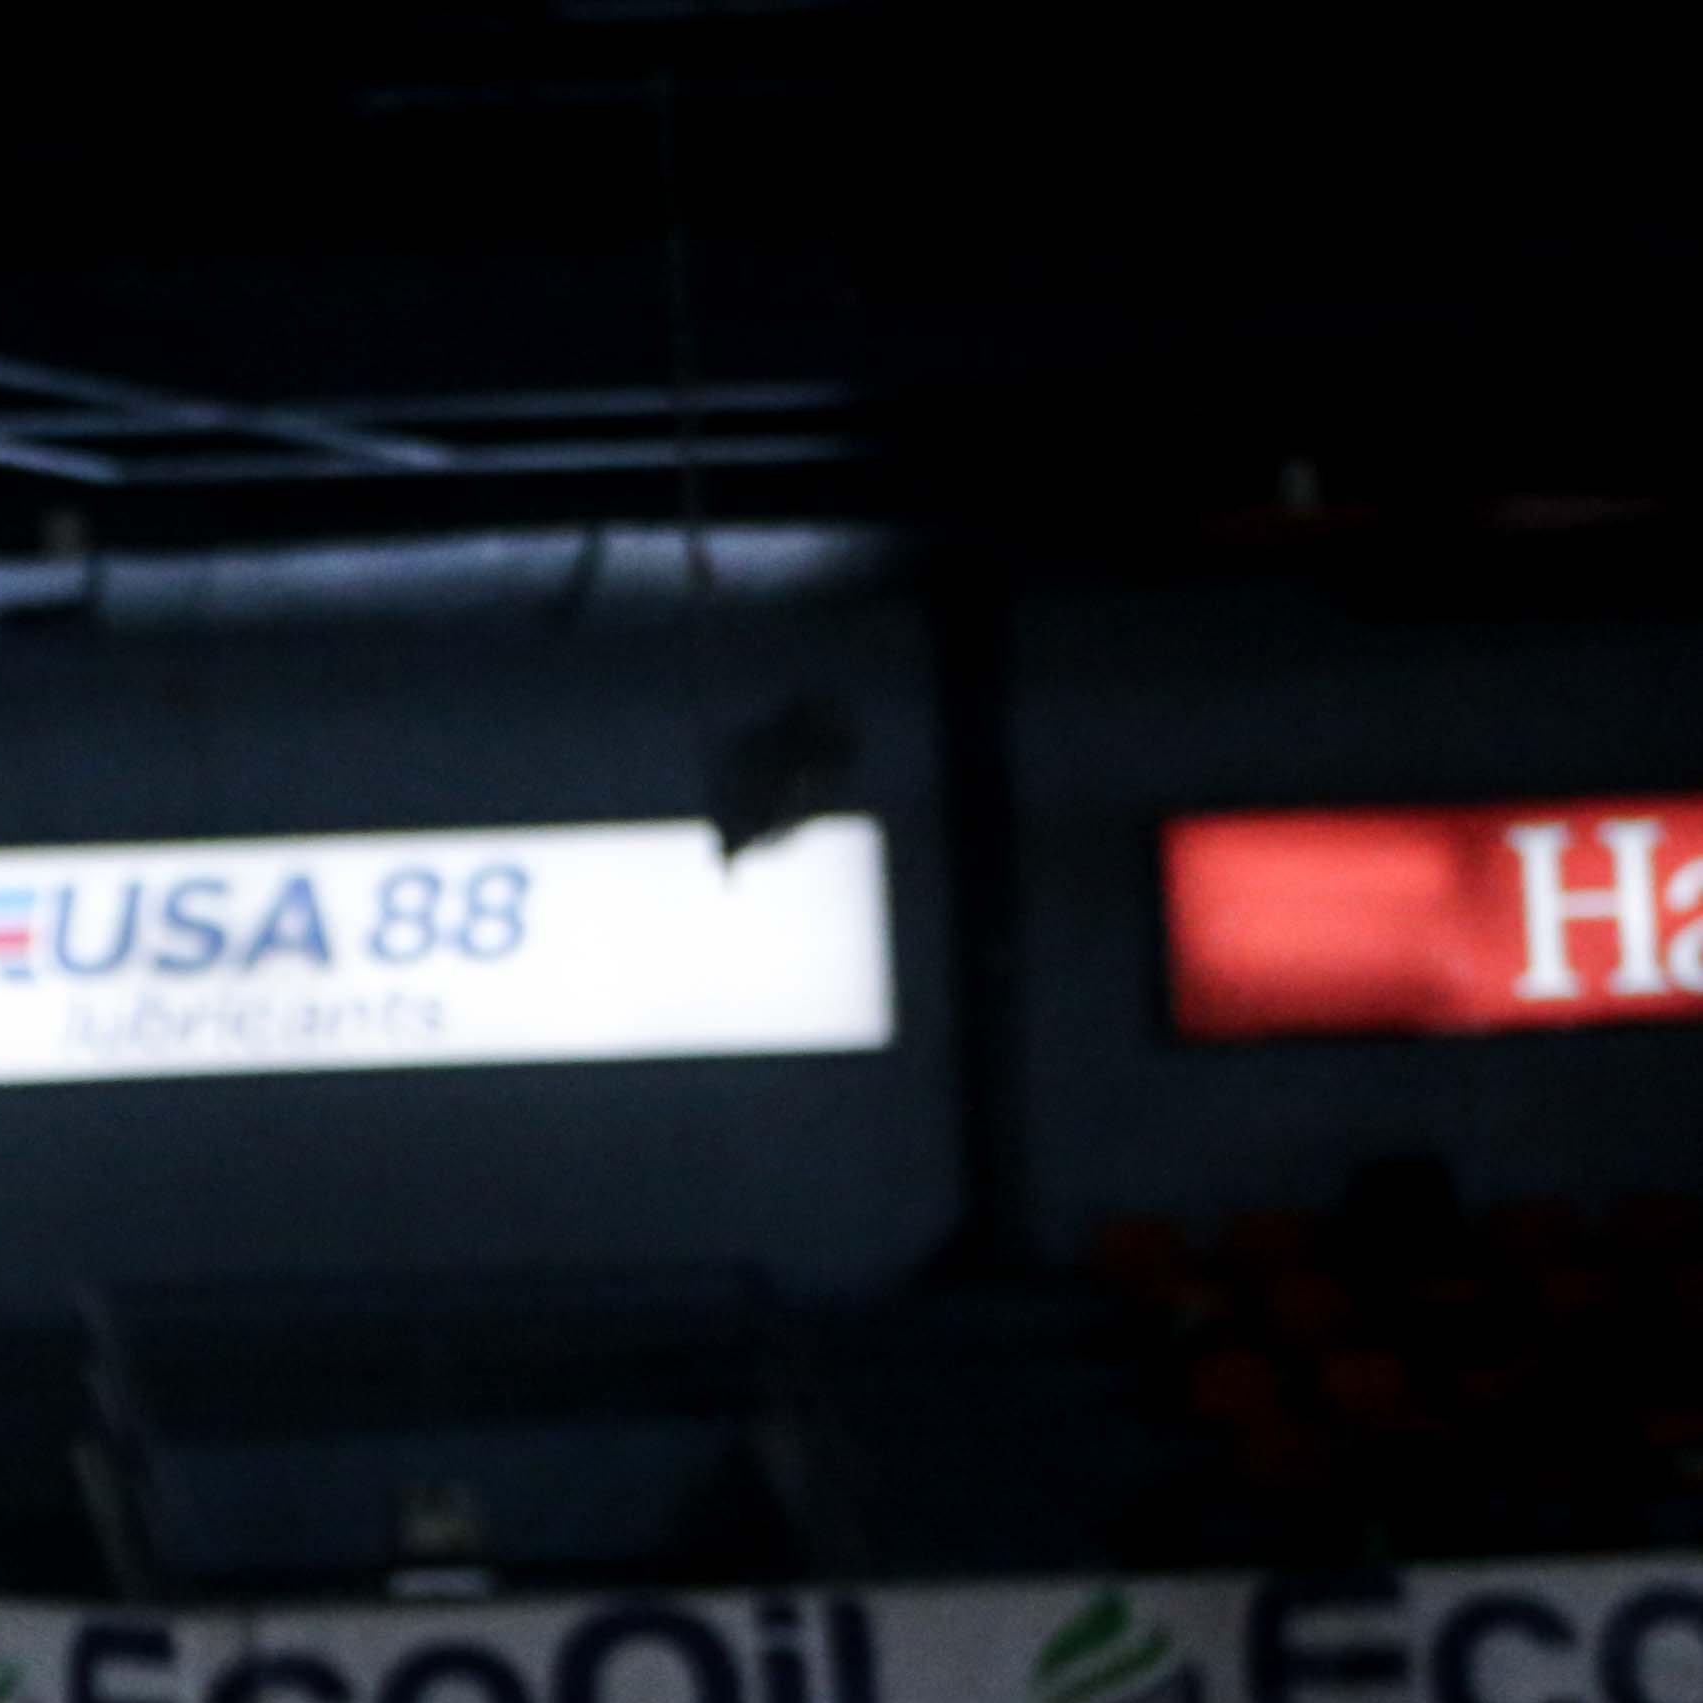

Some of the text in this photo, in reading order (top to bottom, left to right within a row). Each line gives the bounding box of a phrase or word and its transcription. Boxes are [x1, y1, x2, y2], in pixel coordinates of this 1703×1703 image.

[51, 864, 531, 980] USA 88
[64, 986, 446, 1054] lubricants
